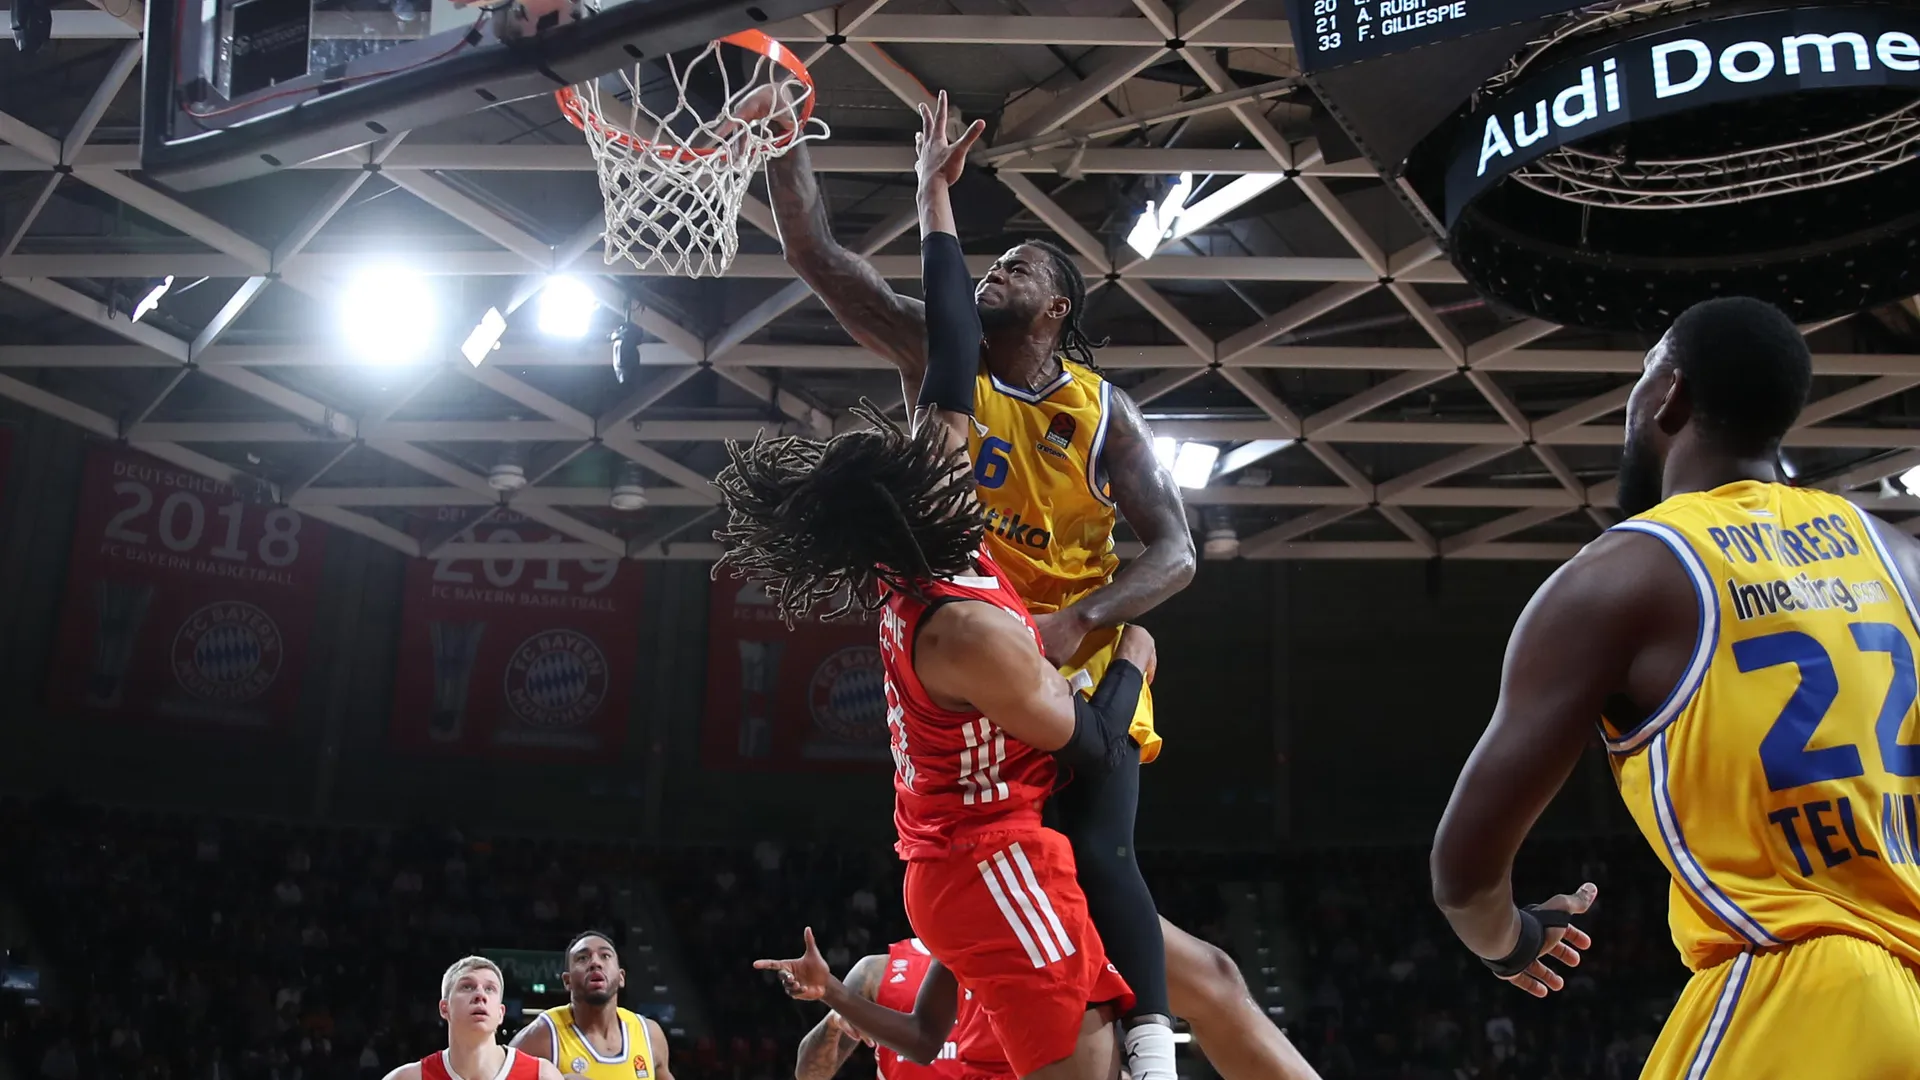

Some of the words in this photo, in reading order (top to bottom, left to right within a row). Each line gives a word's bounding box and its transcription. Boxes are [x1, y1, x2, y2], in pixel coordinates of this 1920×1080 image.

[1314, 0, 1337, 16] 20
[1316, 15, 1336, 34] 21
[1357, 7, 1373, 23] A.
[1318, 32, 1341, 51] 33
[1358, 24, 1375, 42] F.
[1382, 0, 1467, 36] GILLESPIE
[1476, 57, 1621, 178] Audi
[1650, 31, 1920, 99] Dome
[974, 436, 1013, 489] 6
[104, 481, 303, 567] 2018
[983, 506, 1052, 550] tika
[100, 543, 121, 558] FC
[125, 549, 192, 572] BAYERN
[195, 561, 298, 586] BASKETBALL
[432, 584, 451, 599] FC
[455, 586, 516, 606] BAYERN
[520, 592, 616, 612] BASKETBALL
[211, 605, 279, 653] BAYERN
[540, 634, 603, 677] BAYERN
[1732, 622, 1920, 792] 22
[1768, 797, 1880, 877] TEL
[502, 957, 566, 983] BayW
